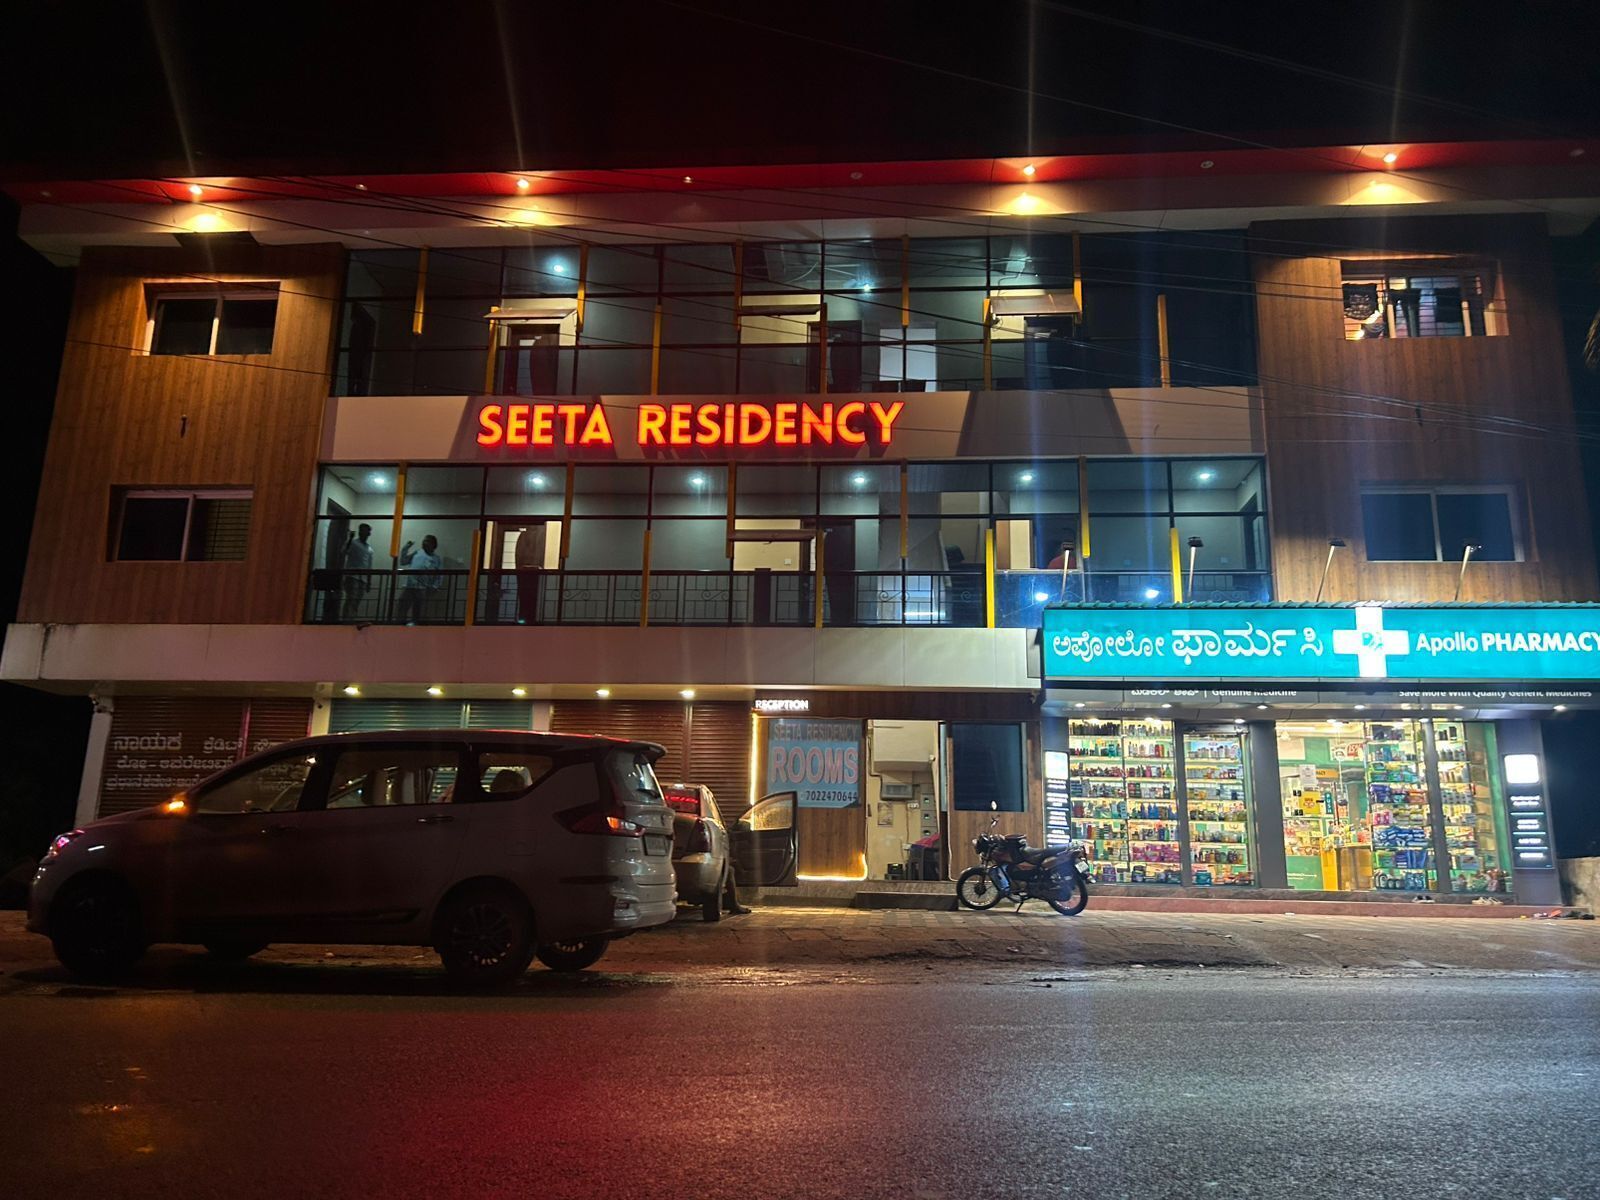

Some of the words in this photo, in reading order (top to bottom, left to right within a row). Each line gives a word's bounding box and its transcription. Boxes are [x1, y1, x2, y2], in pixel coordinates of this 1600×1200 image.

[476, 403, 614, 446] SEETA
[638, 402, 905, 446] RESIDENCY
[1053, 630, 1164, 662] ಅಪೋಲೋ
[1416, 632, 1478, 657] Apollo
[1481, 632, 1600, 652] PHARMACY
[755, 699, 809, 711] RECEPTION
[774, 723, 802, 740] SEETA
[807, 723, 858, 740] RESIDENCY
[772, 746, 859, 784] ROOMS
